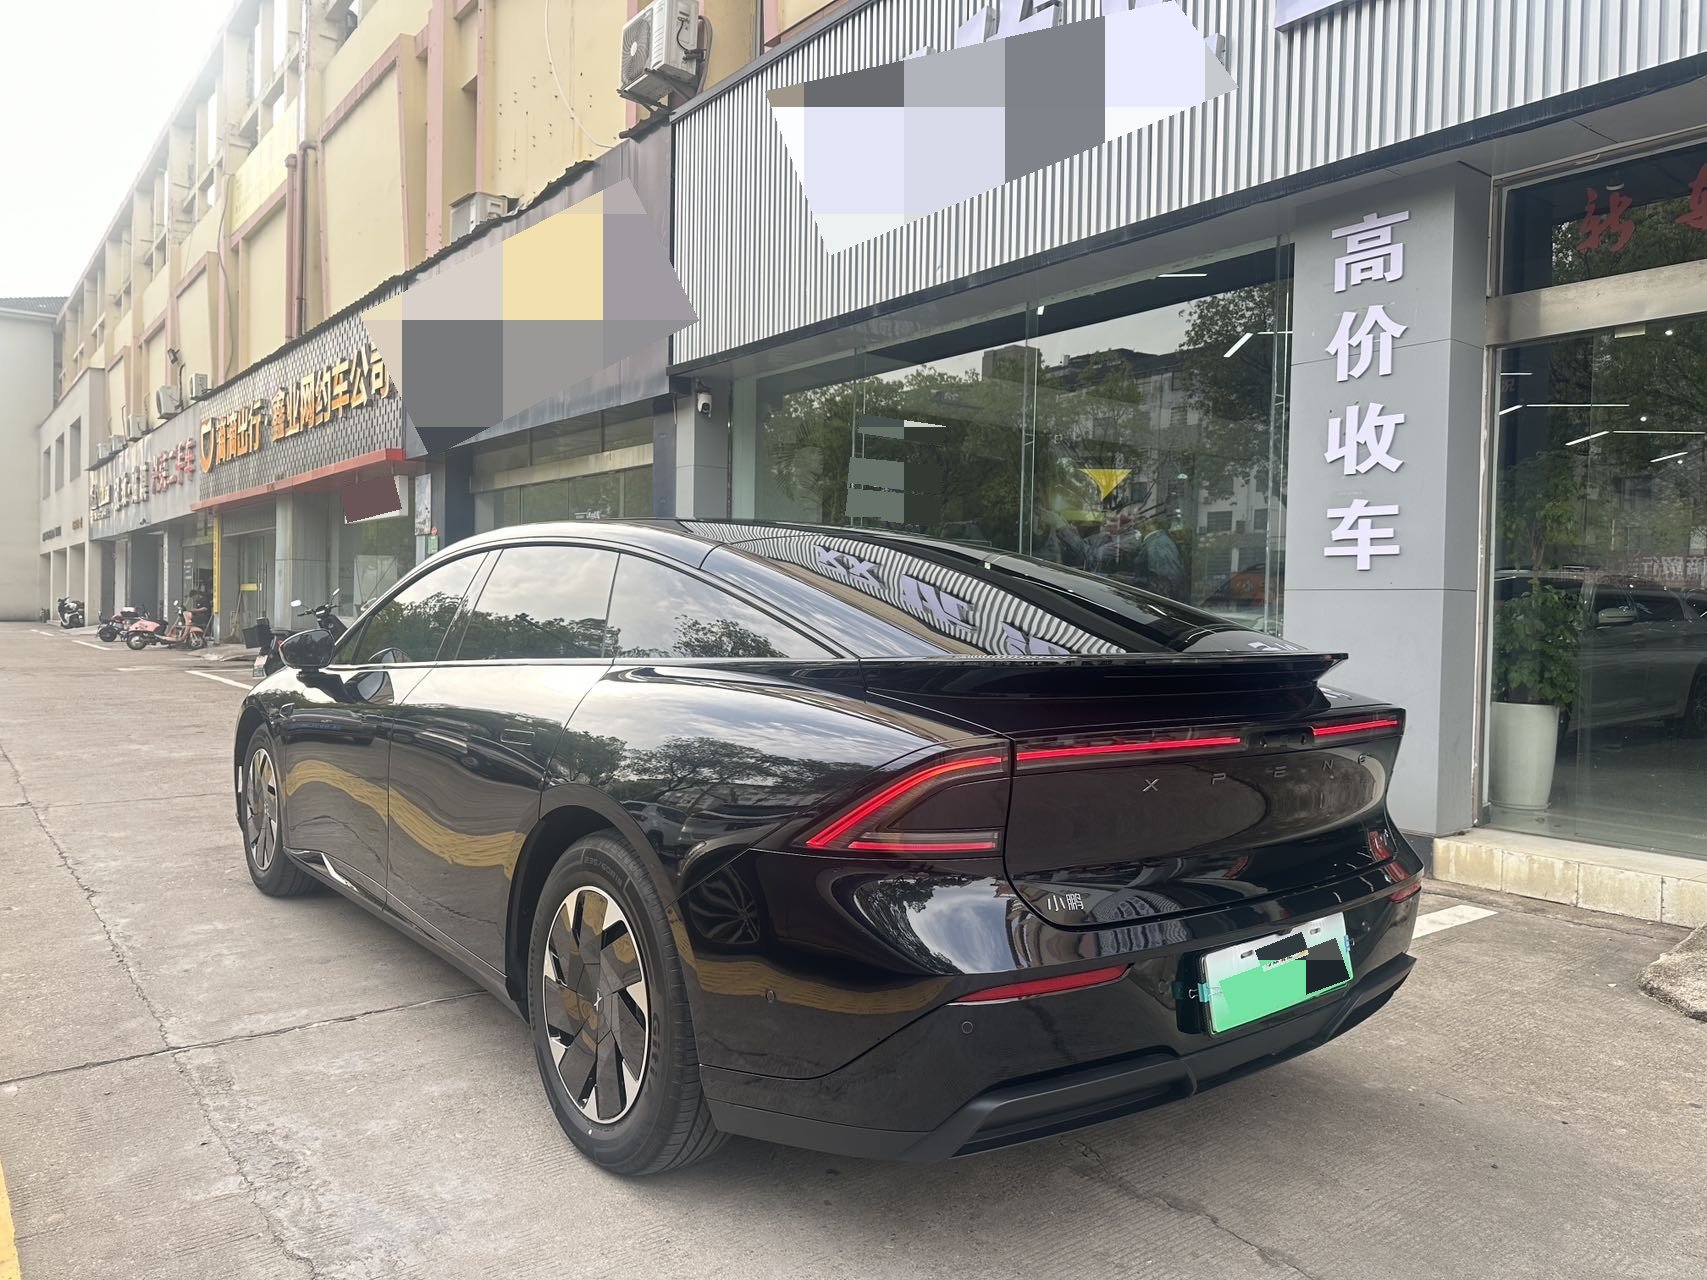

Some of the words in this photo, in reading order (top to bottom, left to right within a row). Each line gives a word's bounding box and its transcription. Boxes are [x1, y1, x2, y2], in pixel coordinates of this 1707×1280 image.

[1324, 210, 1411, 571] 高价收车
[1047, 893, 1085, 912] 小鹏
